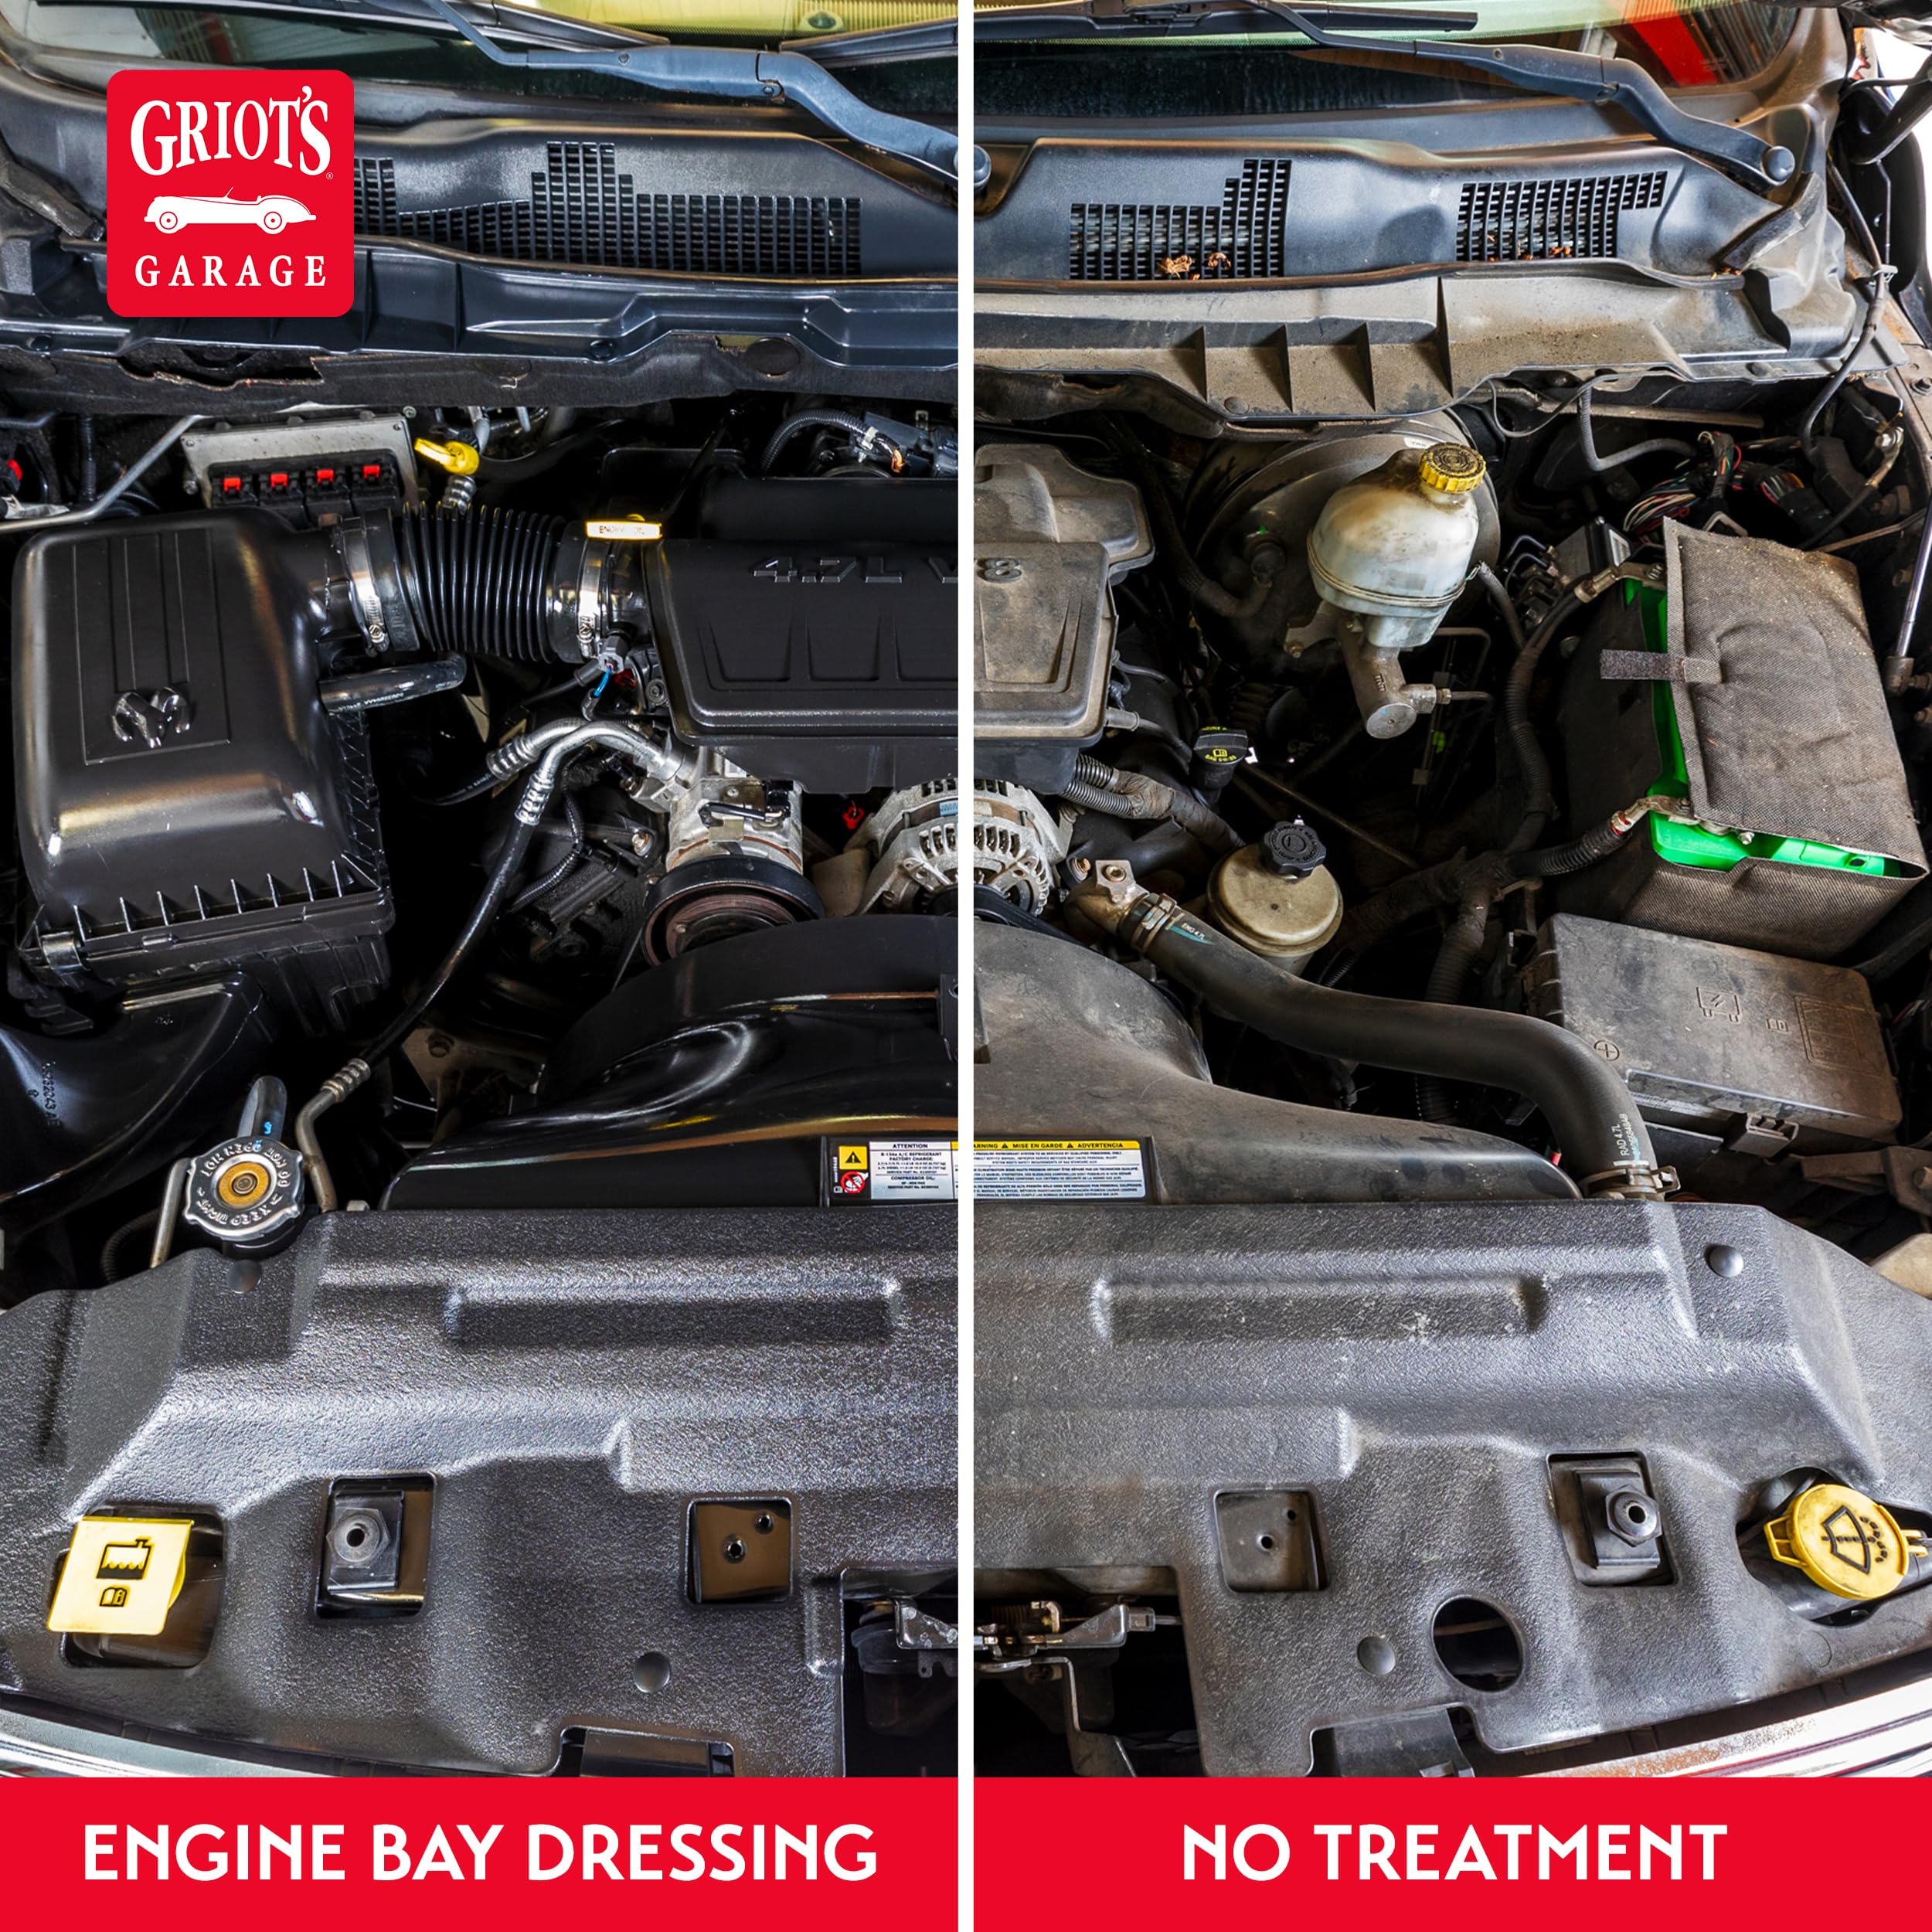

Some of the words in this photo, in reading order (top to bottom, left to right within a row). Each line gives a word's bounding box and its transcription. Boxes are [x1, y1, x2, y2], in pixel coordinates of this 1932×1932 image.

[753, 556, 903, 583] 4.7L
[1617, 1139, 1630, 1156] RAD
[230, 1204, 272, 1226] KEEP
